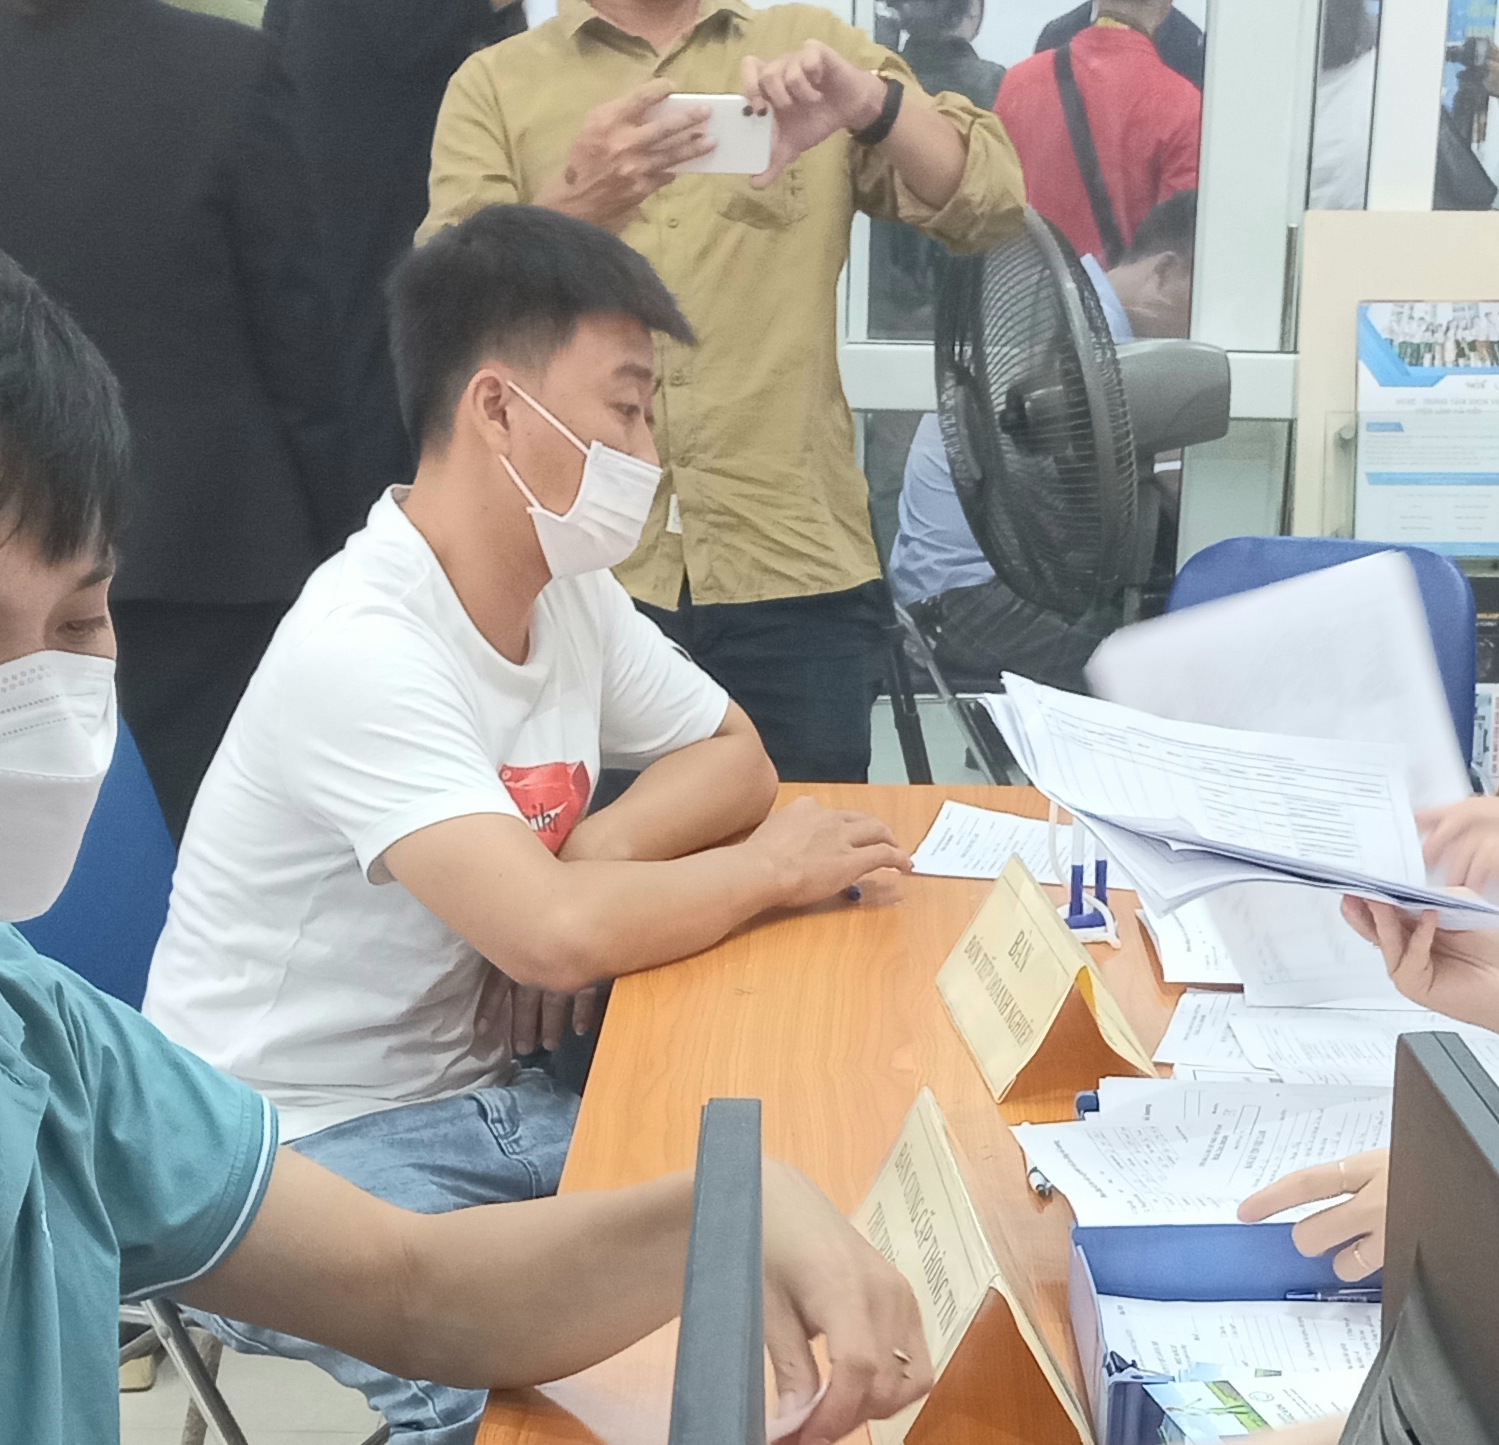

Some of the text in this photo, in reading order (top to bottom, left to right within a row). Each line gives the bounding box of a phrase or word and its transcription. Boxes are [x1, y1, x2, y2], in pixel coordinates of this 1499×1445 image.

[1008, 930, 1033, 972] BÀN
[975, 952, 996, 981] TIẾP
[986, 973, 1014, 1015] DOANH
[1004, 1003, 1033, 1045] NGHIỆP
[895, 1142, 957, 1336] BÀN CUNG CẤP THÔNG TIN
